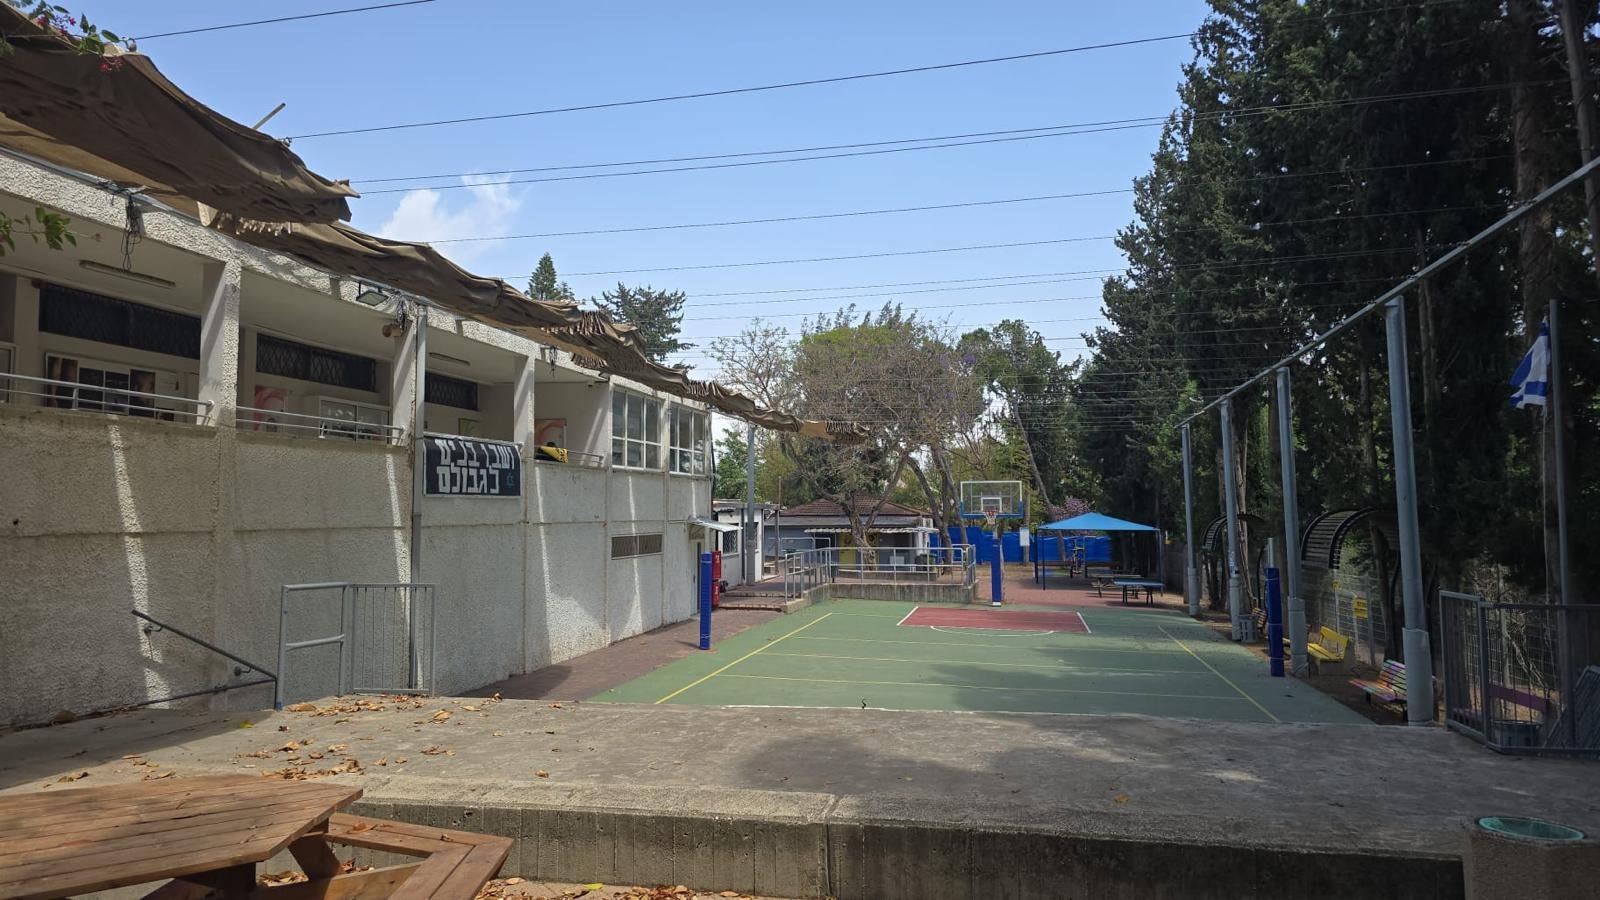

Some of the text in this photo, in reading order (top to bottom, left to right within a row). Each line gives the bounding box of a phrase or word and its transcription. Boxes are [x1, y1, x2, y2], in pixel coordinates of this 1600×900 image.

[434, 439, 514, 470] ושבו בנים
[436, 462, 500, 494] לגבולם
